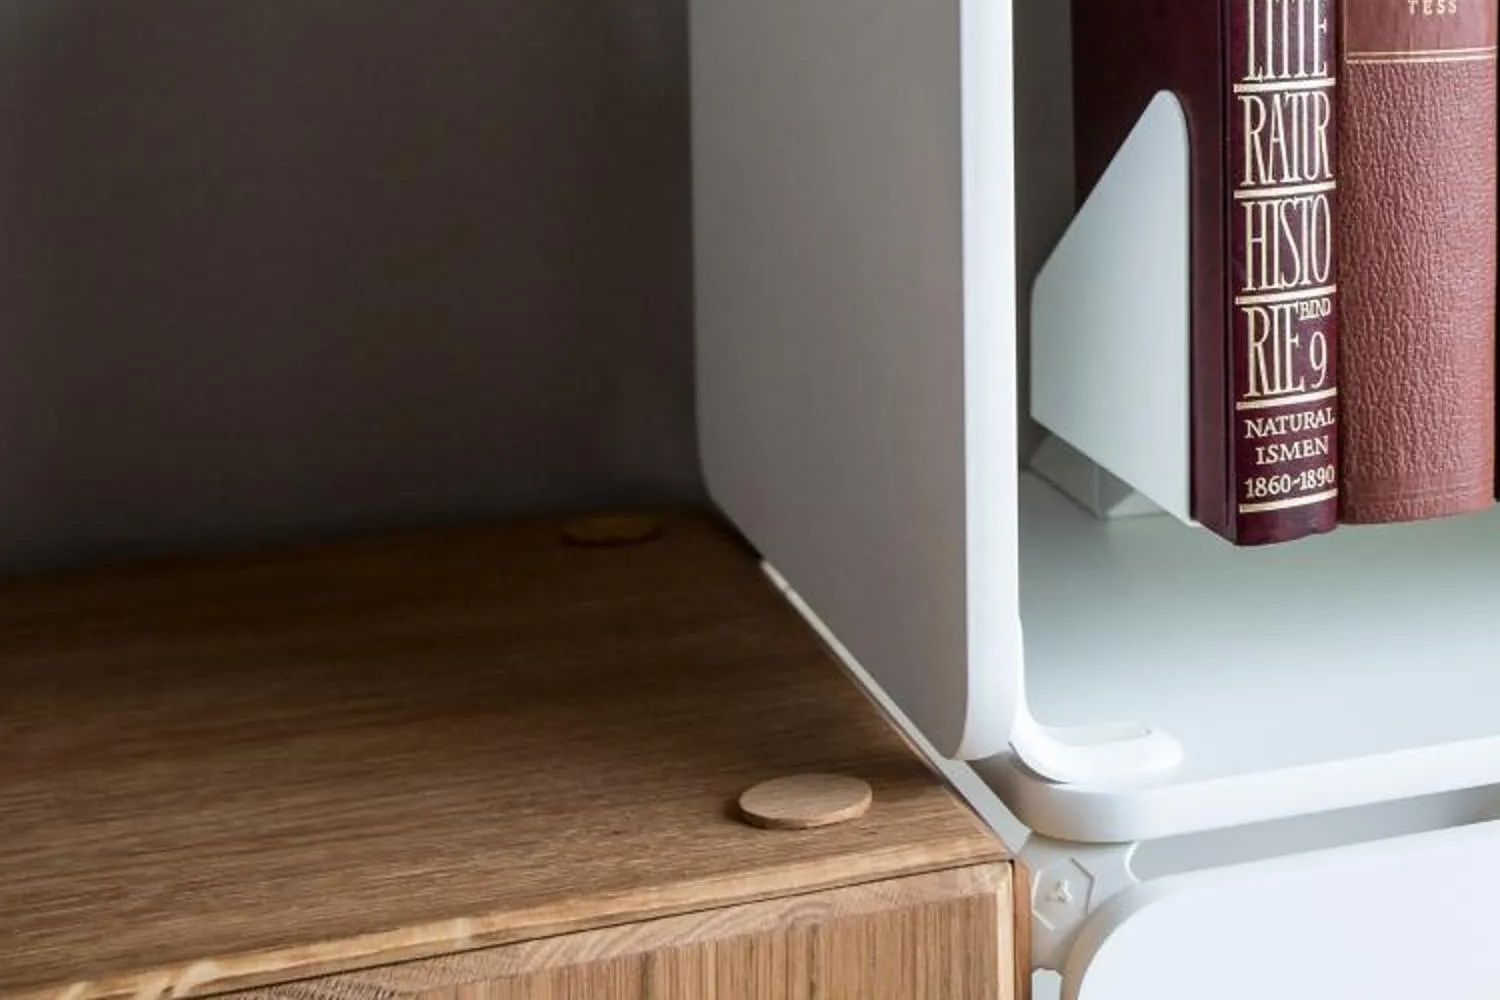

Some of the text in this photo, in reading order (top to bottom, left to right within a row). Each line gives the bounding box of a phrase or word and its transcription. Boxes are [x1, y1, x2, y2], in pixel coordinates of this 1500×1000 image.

[1237, 91, 1334, 186] RATUR
[1241, 194, 1331, 291] HISTO
[1242, 301, 1305, 398] RIE
[1309, 331, 1328, 389] 9
[1244, 407, 1335, 439] NATURAL
[1255, 435, 1330, 465] ISMEN
[1244, 464, 1336, 498] 1860-1890
